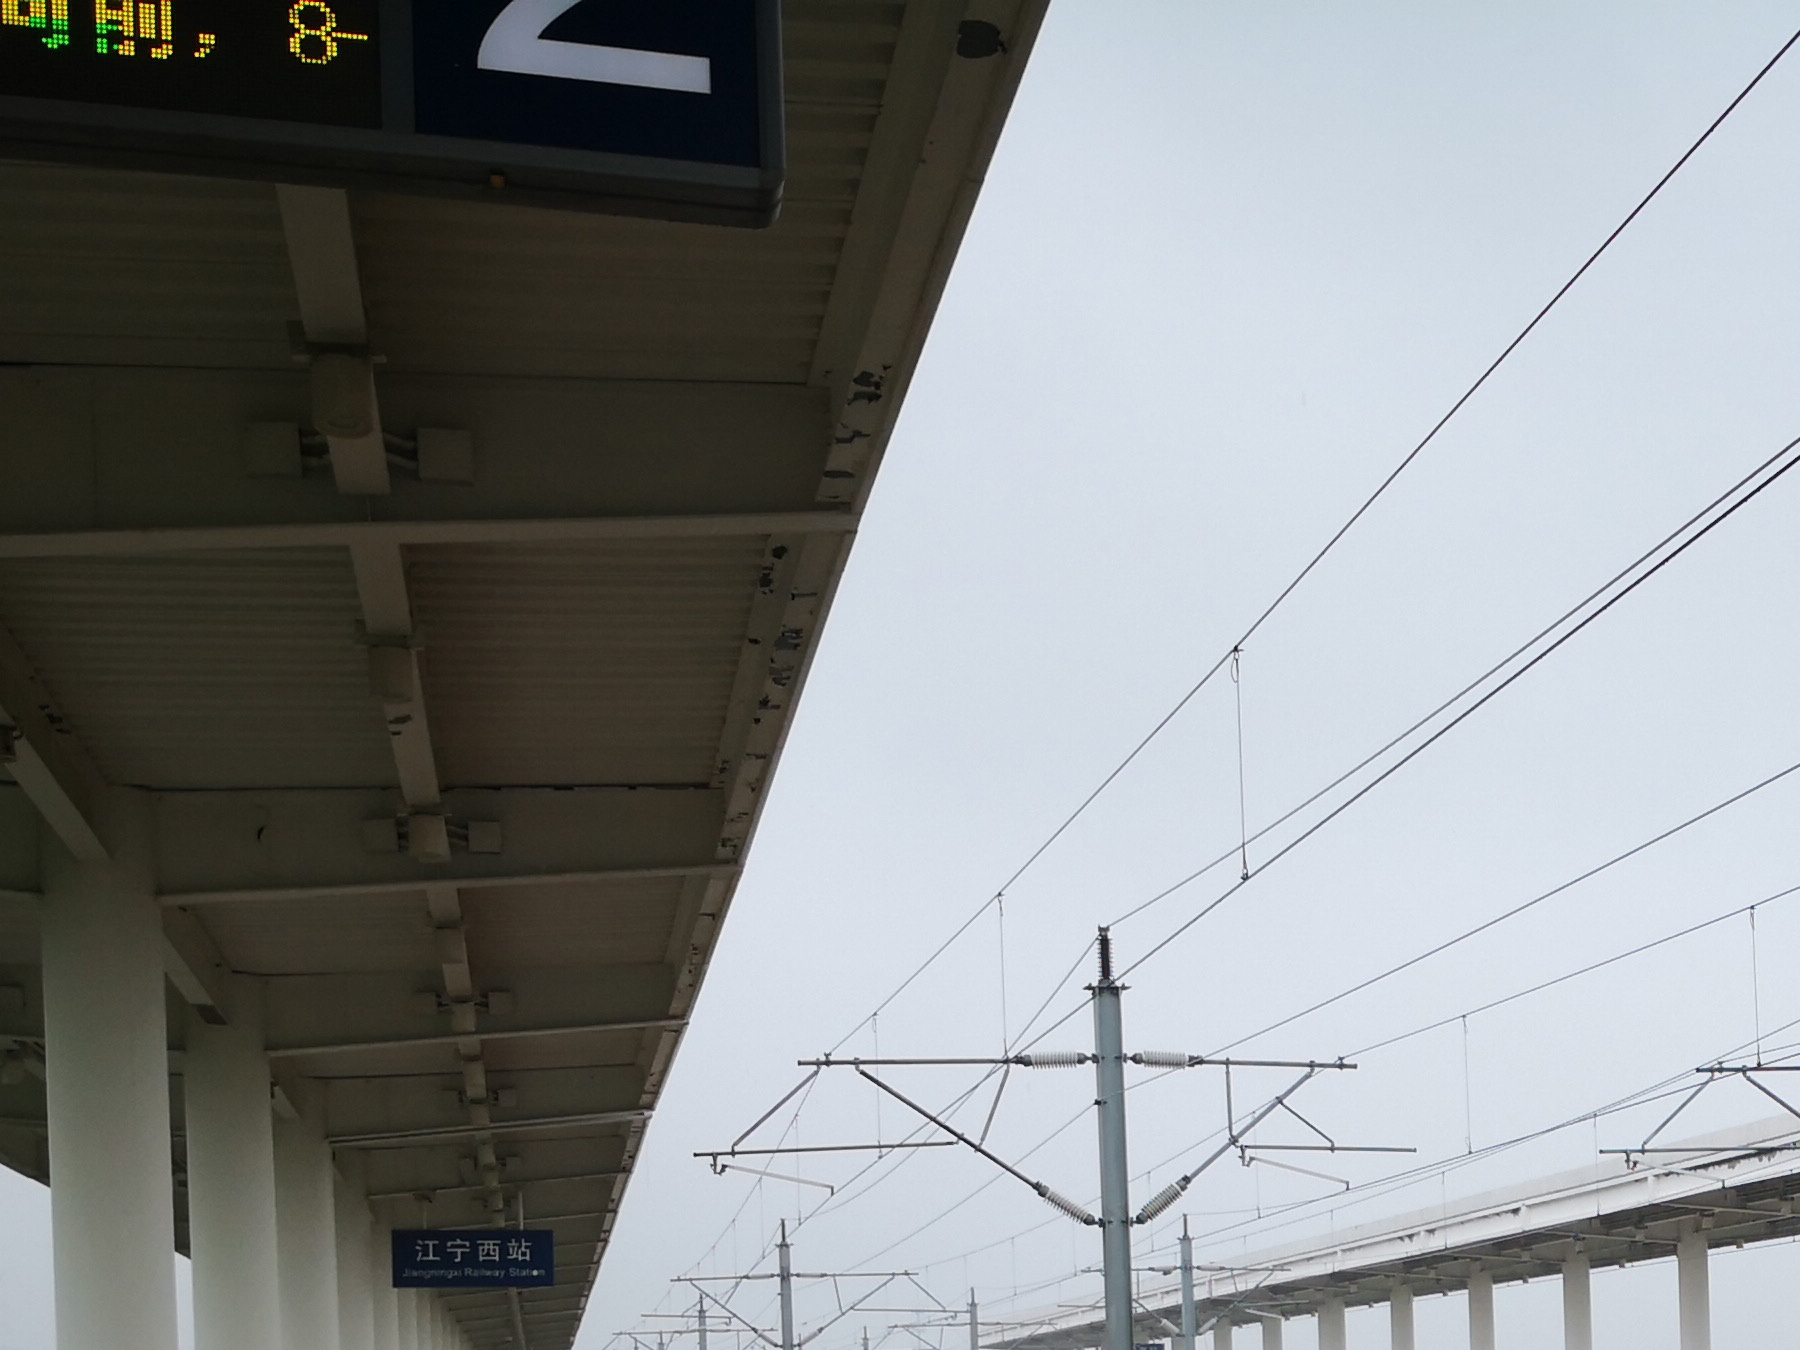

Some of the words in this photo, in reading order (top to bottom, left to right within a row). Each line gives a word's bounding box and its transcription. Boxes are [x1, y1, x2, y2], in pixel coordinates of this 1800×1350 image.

[415, 1238, 532, 1263] 江宁西站
[464, 1267, 505, 1279] Railway
